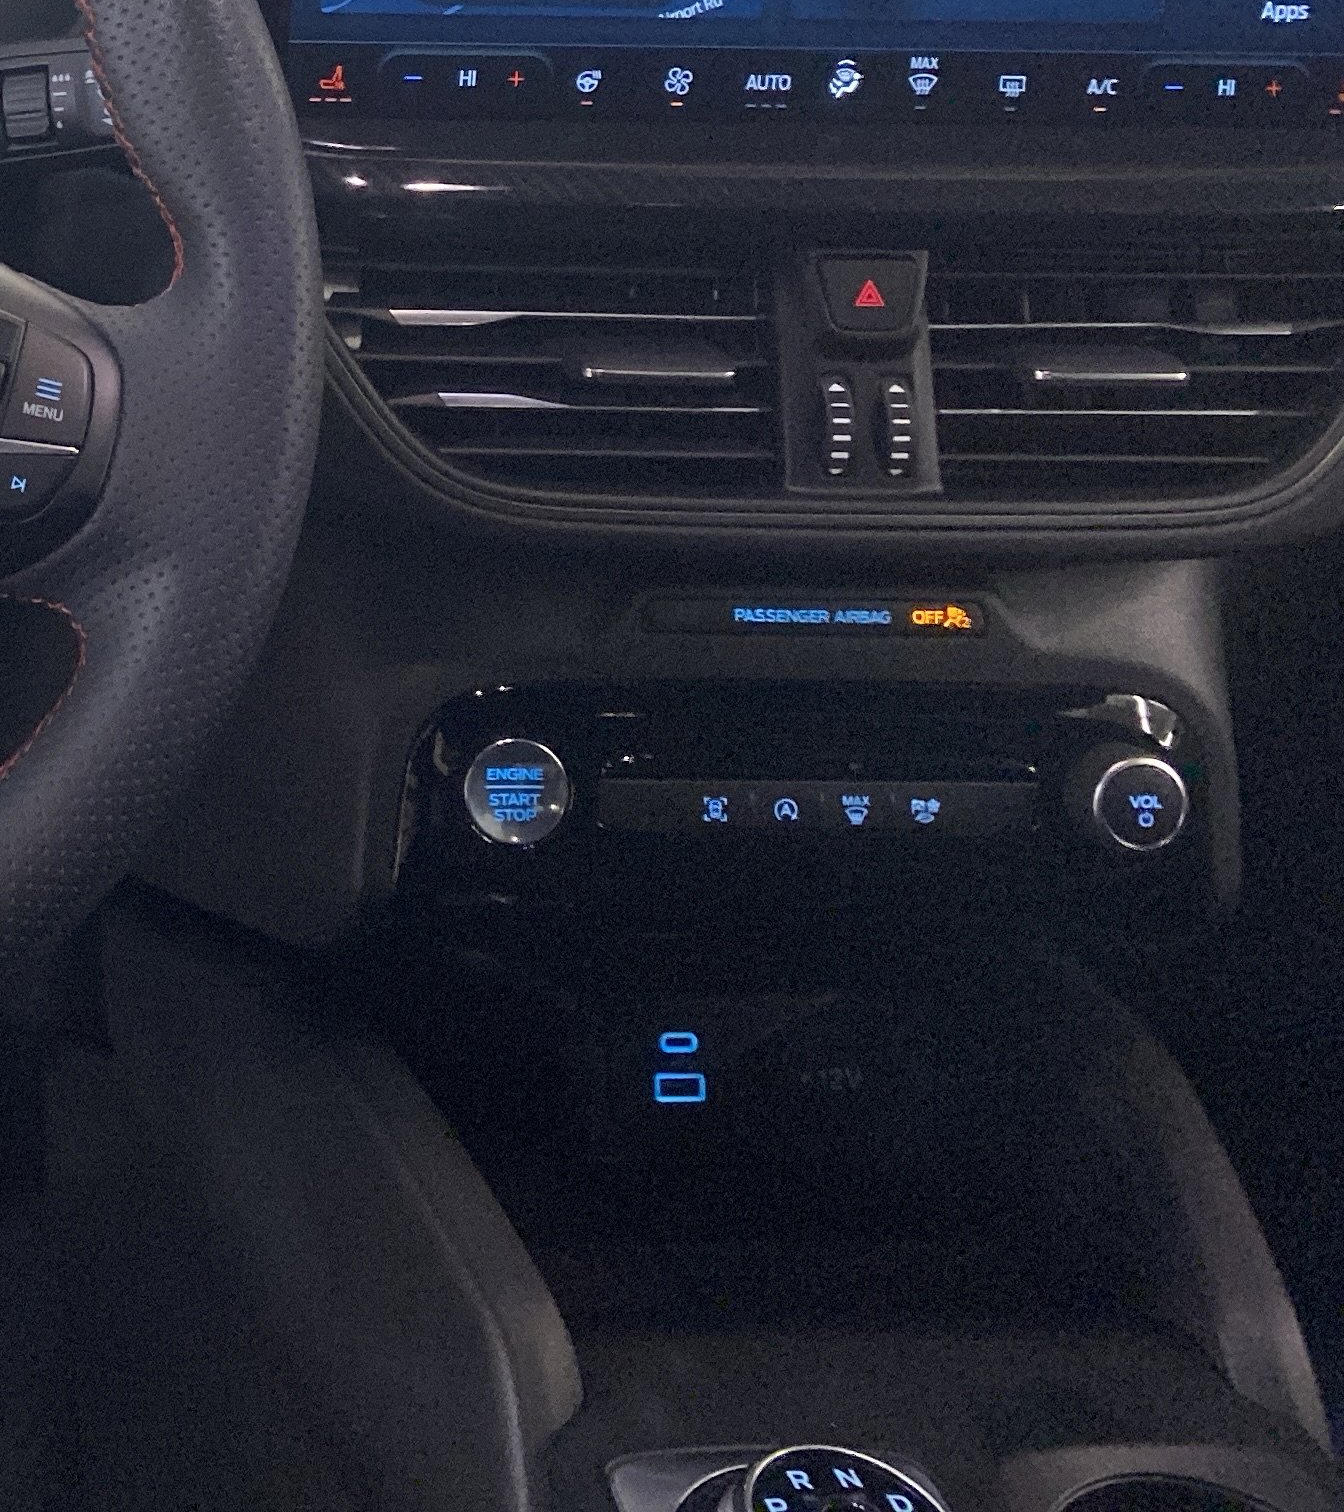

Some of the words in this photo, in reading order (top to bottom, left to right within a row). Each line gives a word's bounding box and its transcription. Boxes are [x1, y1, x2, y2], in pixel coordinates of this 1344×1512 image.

[1261, 0, 1310, 23] Apps
[910, 56, 940, 70] MAX
[458, 69, 477, 87] HI
[745, 73, 792, 92] AUTO
[1086, 78, 1119, 96] A/C
[1218, 79, 1236, 96] HI
[22, 401, 64, 423] MENU
[733, 607, 830, 624] PASSENGER
[833, 608, 893, 625] AIRBAG
[910, 610, 944, 626] OFF
[485, 767, 545, 781] ENGINE
[488, 792, 542, 806] START
[841, 795, 871, 806] MAX
[1129, 795, 1164, 810] VOL
[494, 808, 537, 822] STOP
[785, 1469, 815, 1490] R
[831, 1467, 864, 1489] N
[884, 1492, 915, 1512] D
